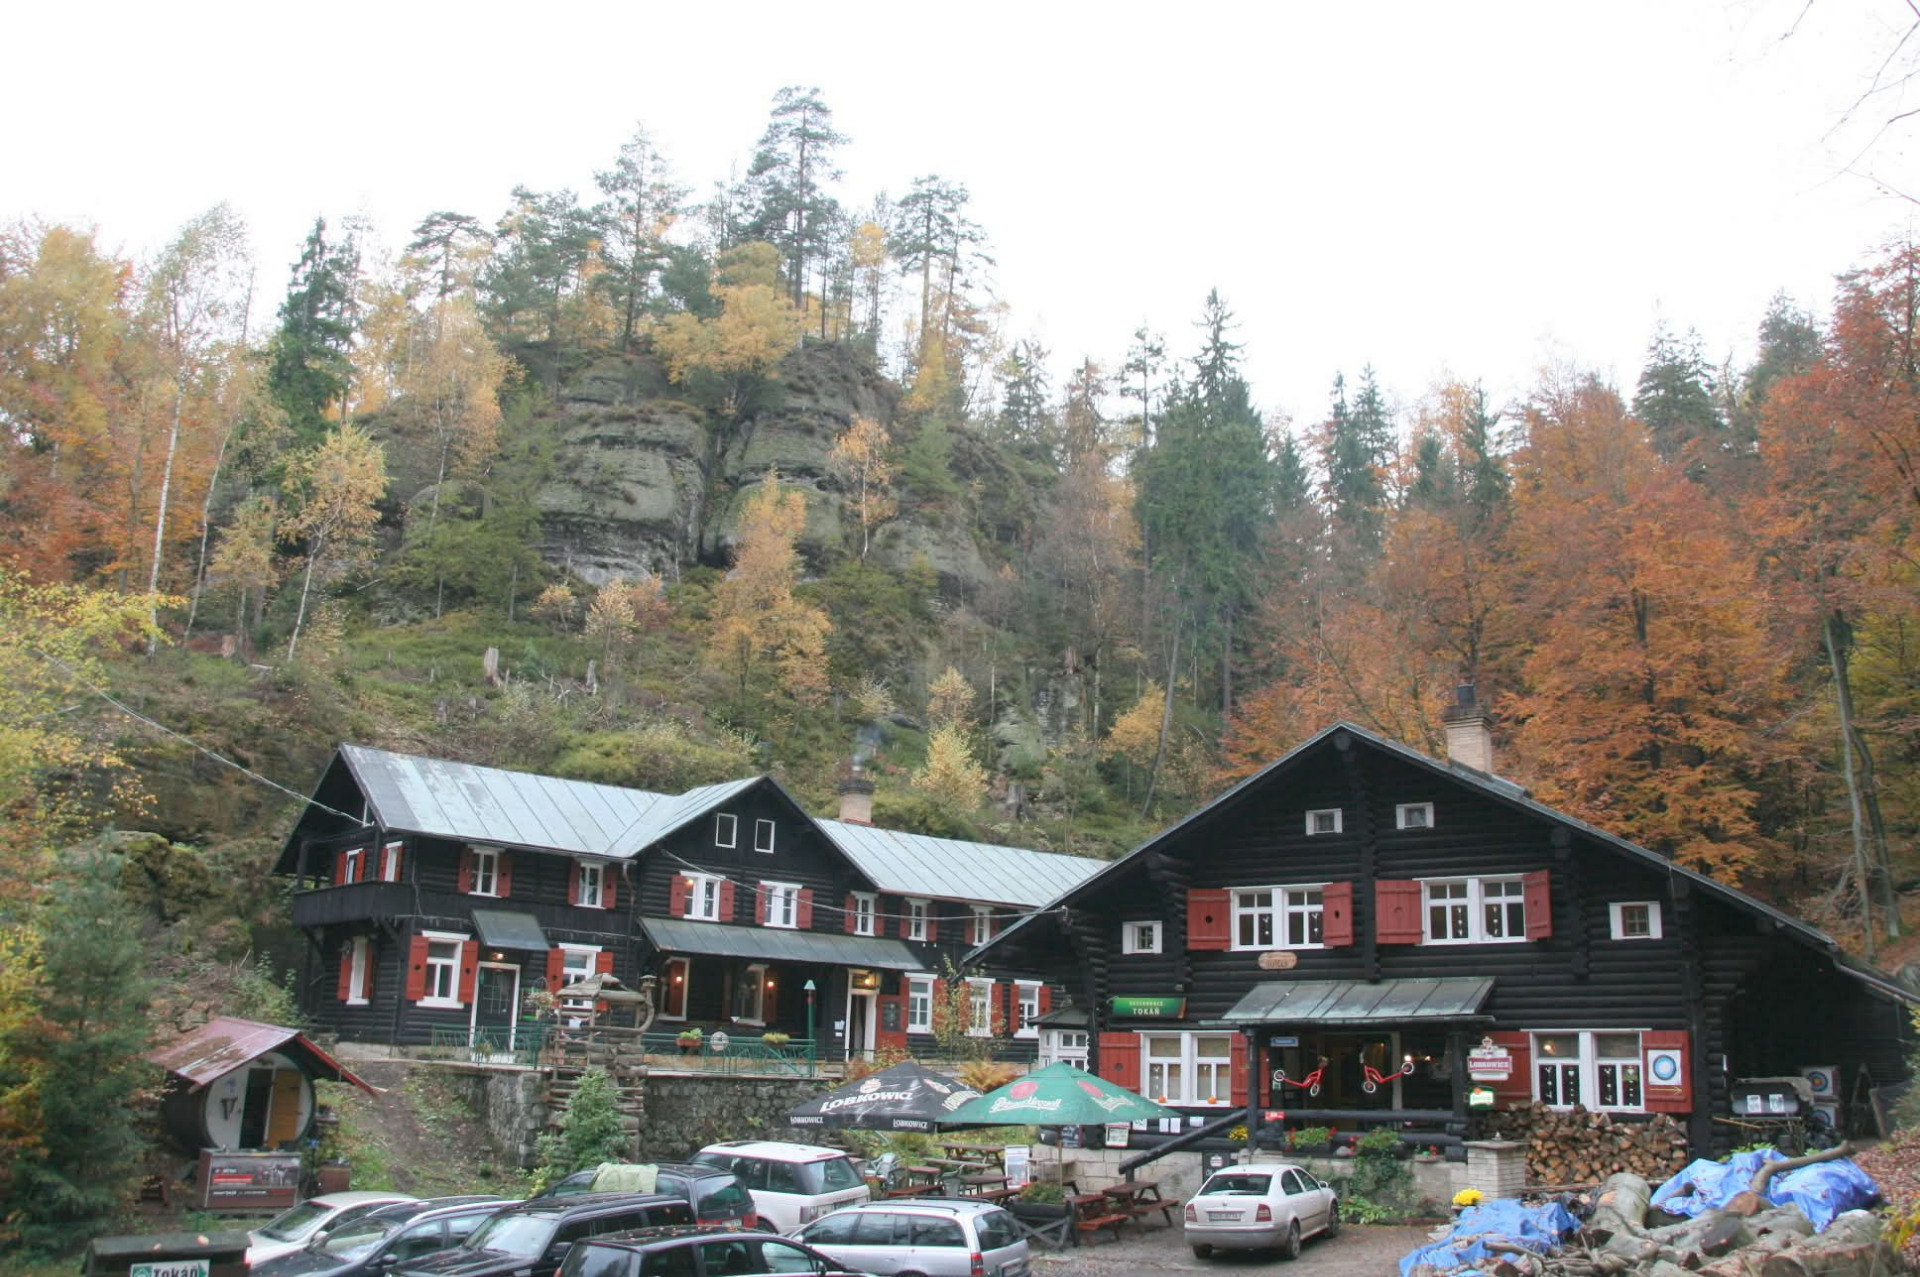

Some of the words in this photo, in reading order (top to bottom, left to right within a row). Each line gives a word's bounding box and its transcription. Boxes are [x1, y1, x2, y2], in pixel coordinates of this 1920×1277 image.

[820, 1091, 913, 1113] LOBKOWICZ
[790, 1116, 824, 1125] LOBKOWICZ
[893, 1118, 929, 1129] LOBKOWICZ
